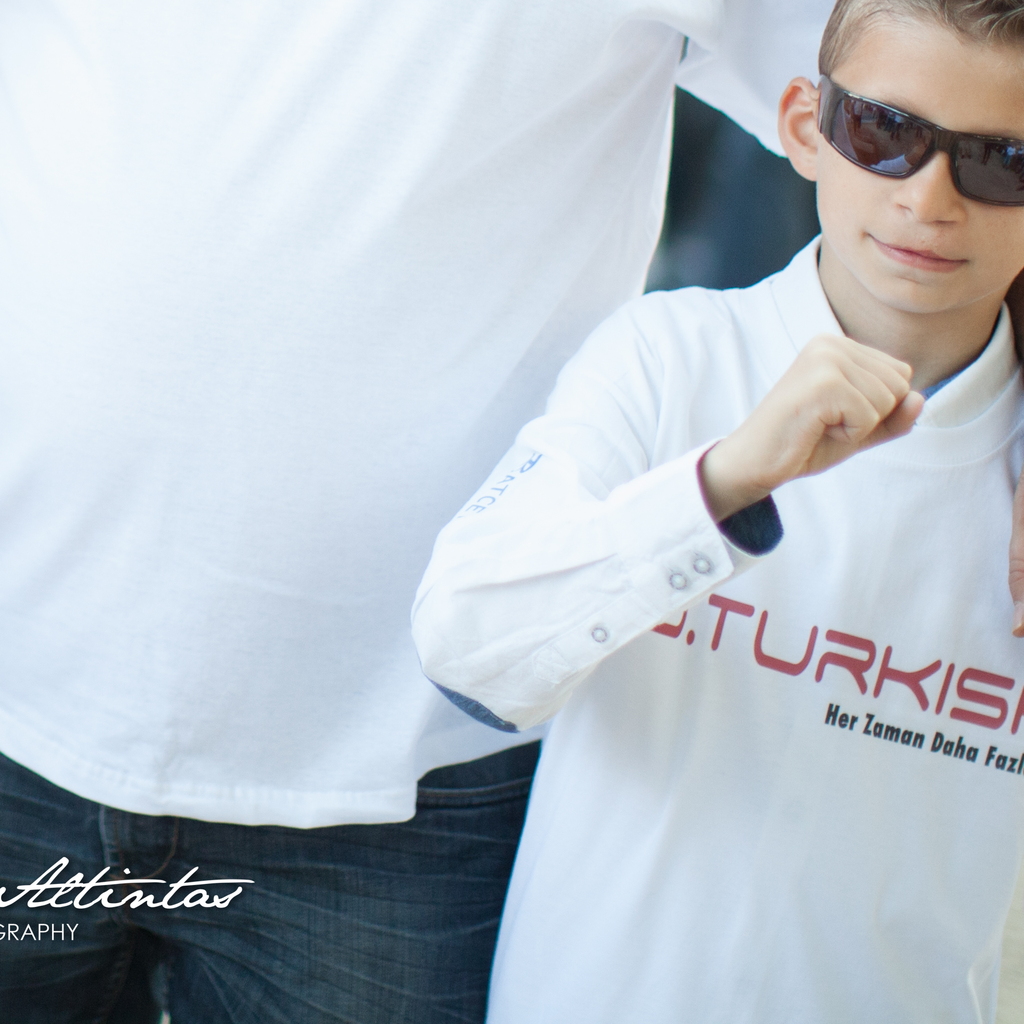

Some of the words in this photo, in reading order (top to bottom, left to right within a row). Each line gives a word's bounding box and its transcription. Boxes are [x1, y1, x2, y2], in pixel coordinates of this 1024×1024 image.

[651, 593, 1024, 735] .TURKIS
[824, 703, 859, 731] Her
[862, 713, 926, 749] Zaman
[930, 731, 980, 763] Daha
[984, 745, 1024, 776] Fazl
